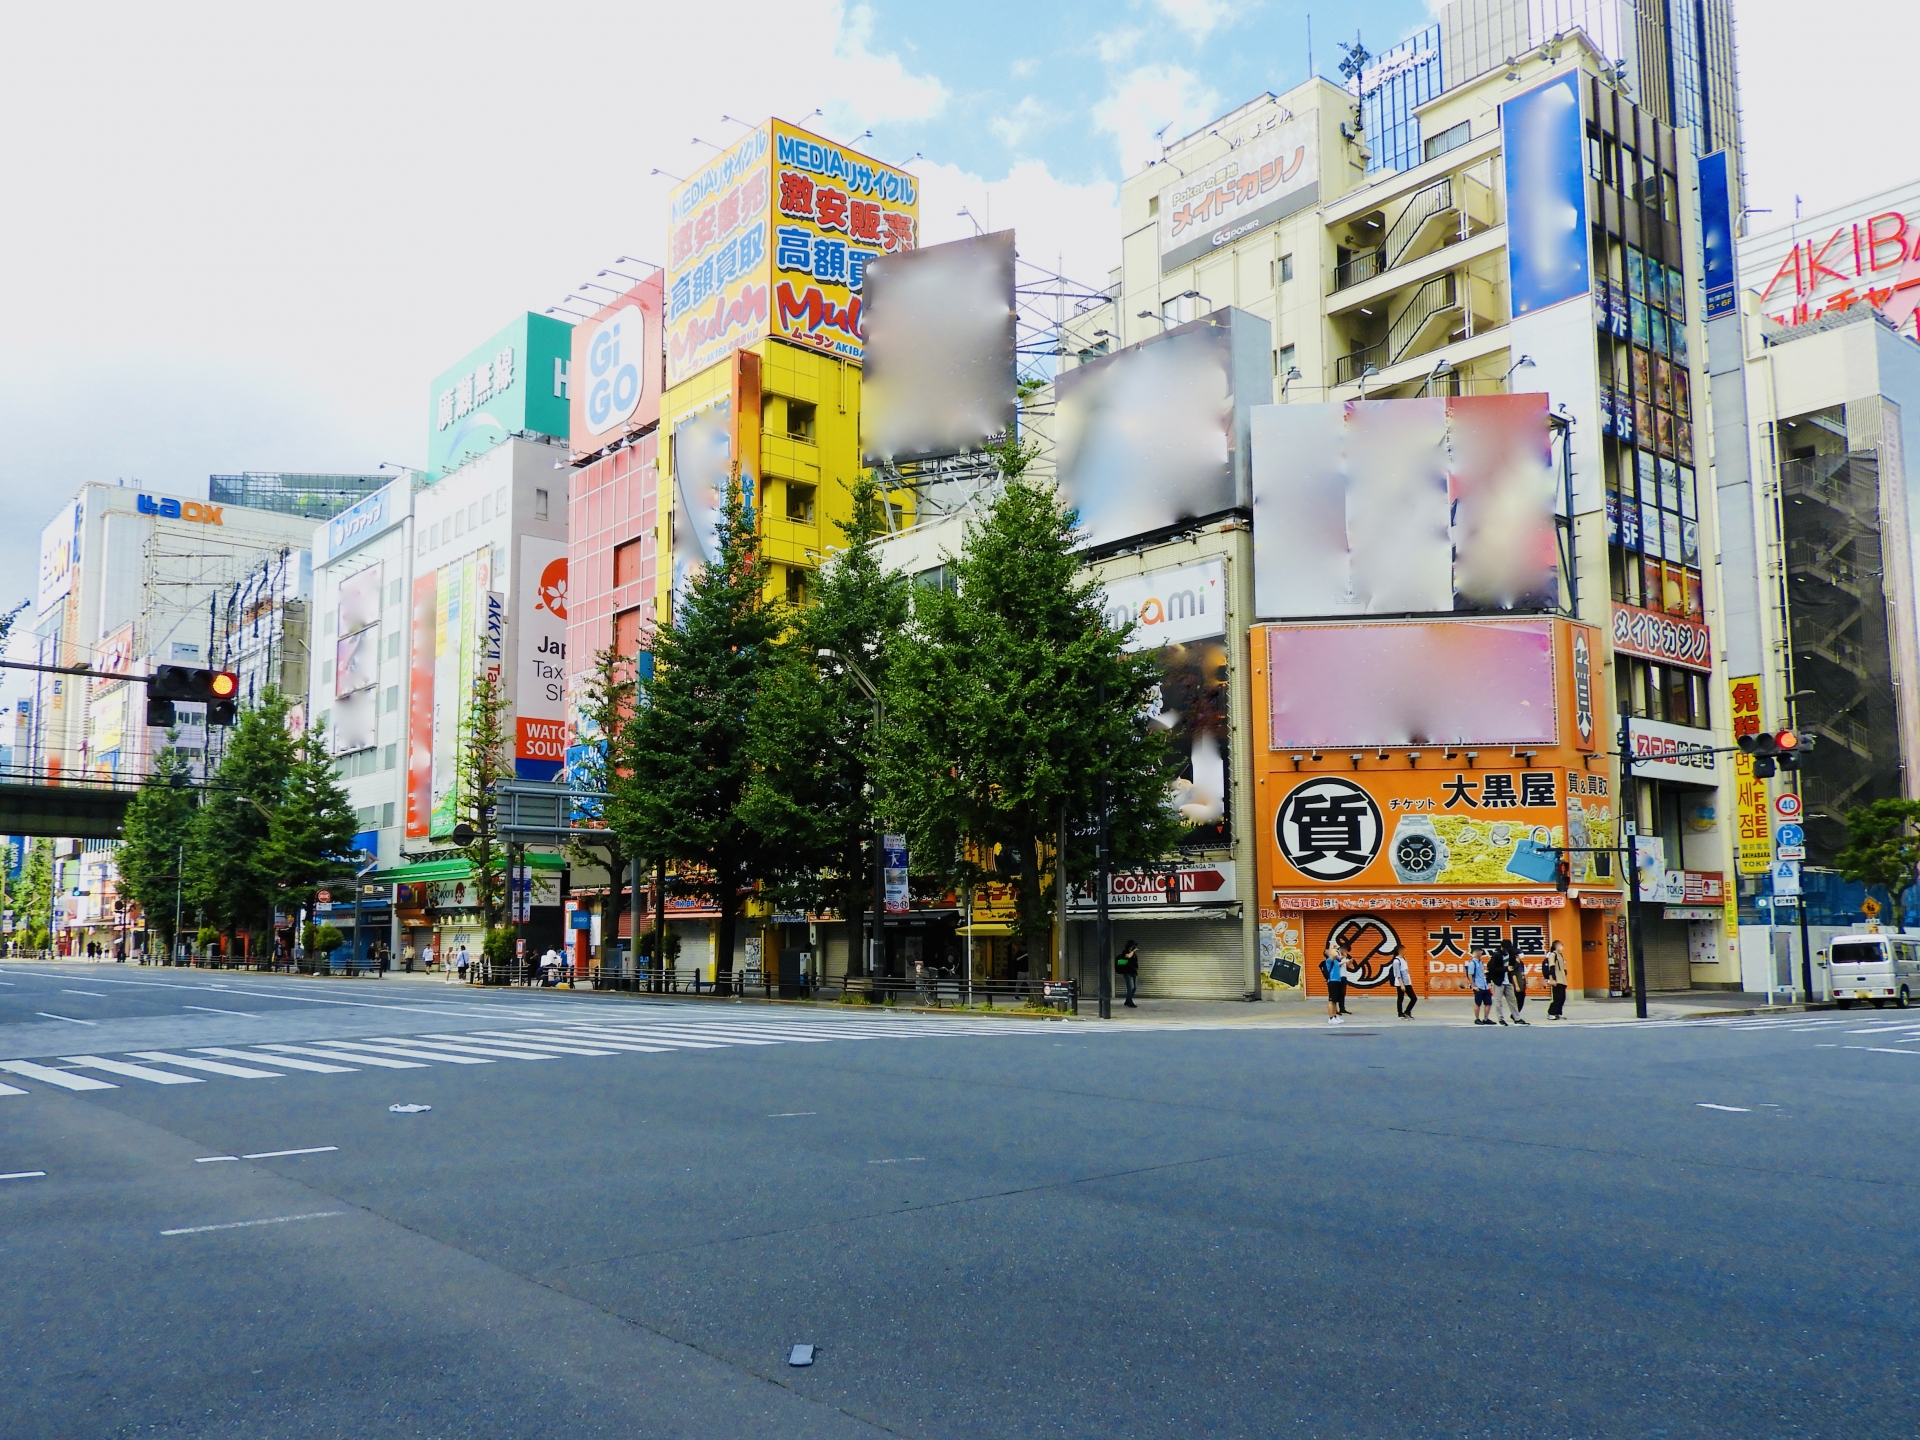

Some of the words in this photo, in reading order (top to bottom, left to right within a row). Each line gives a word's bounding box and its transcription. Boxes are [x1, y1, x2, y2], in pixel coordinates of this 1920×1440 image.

[777, 134, 914, 205] MEDIAリサイクル
[1171, 145, 1305, 237] メイドカジノ
[779, 171, 913, 251] 激安販売
[1760, 211, 1920, 303] AKIB
[1611, 311, 1627, 337] 7F
[791, 326, 835, 350] ムーラン
[1617, 413, 1633, 439] 6F
[1622, 520, 1639, 546] 5F
[1613, 609, 1707, 663] メイドカジノ
[1389, 797, 1436, 811] チケット
[1442, 771, 1558, 810] 大黒屋
[1781, 799, 1796, 810] 40
[1289, 790, 1371, 869] 質
[1783, 830, 1793, 844] P
[1178, 872, 1195, 892] IN
[1111, 895, 1158, 903] Akihabara
[1455, 908, 1518, 922] チケット
[1428, 925, 1547, 959] 大黒屋
